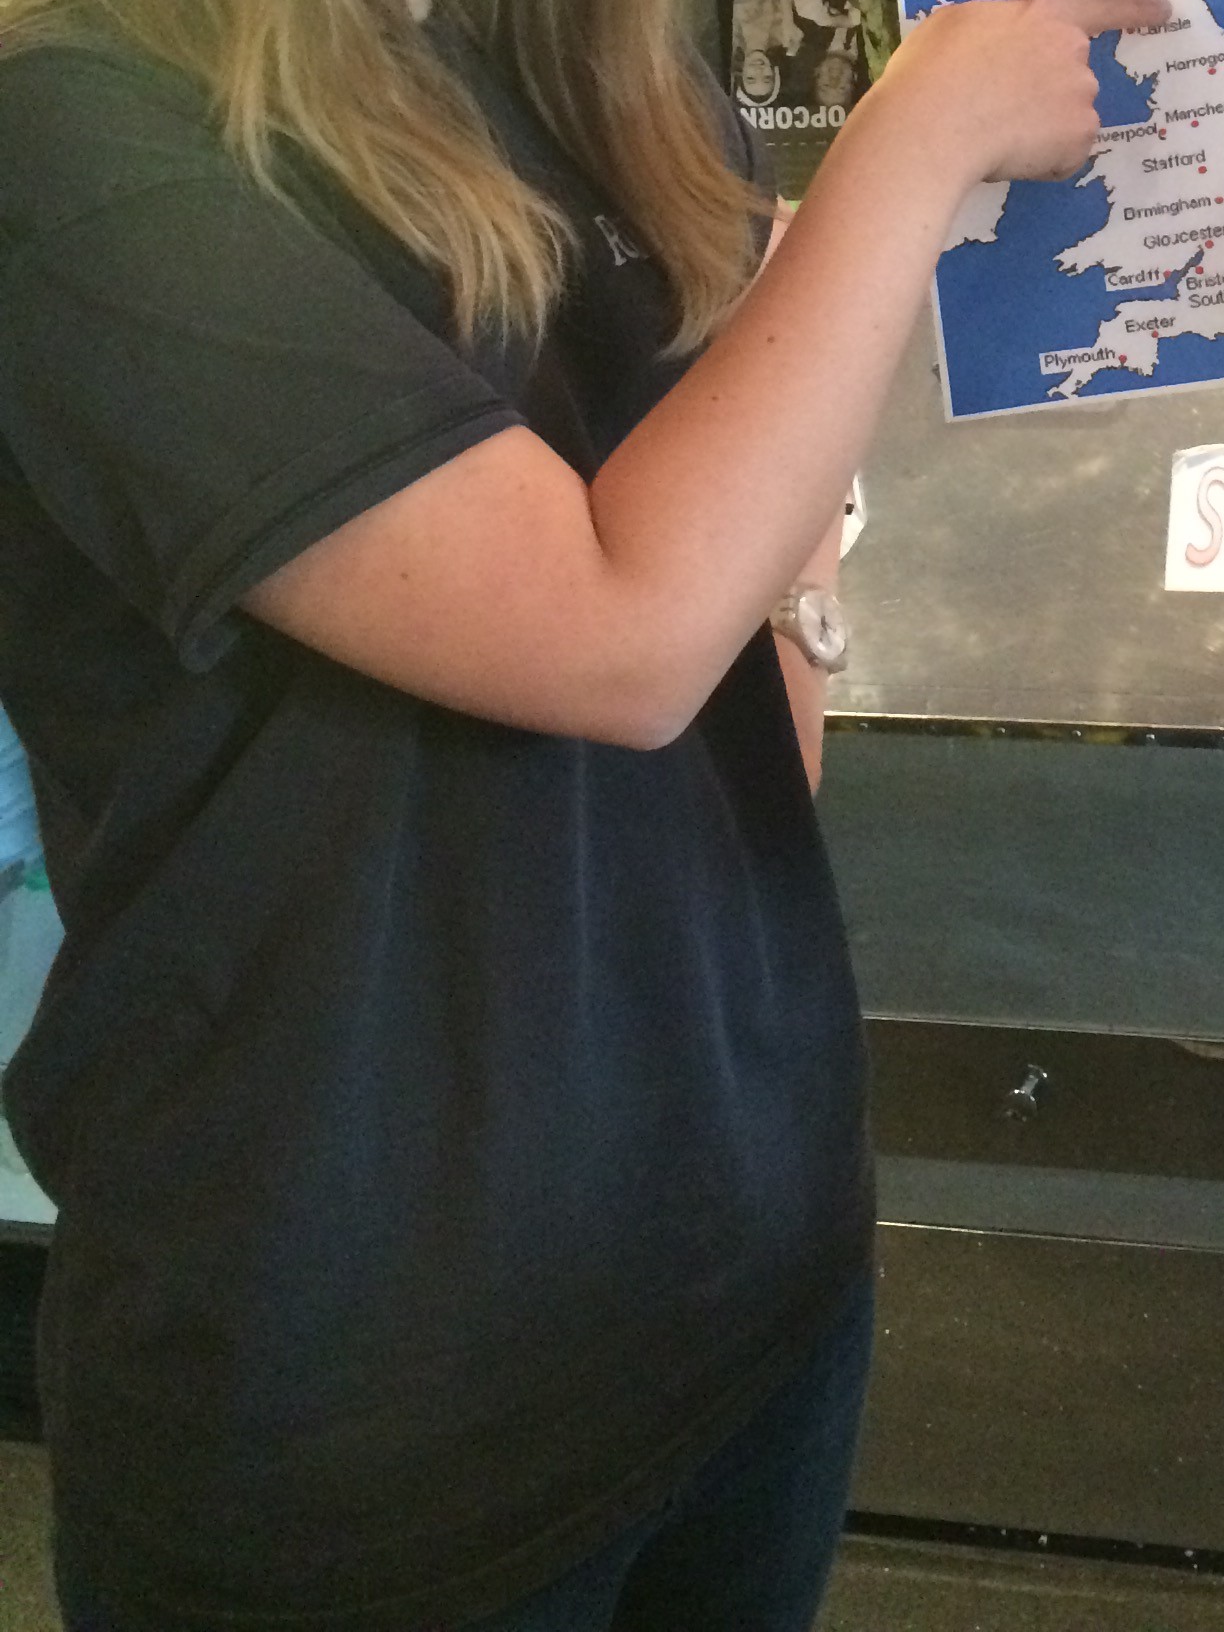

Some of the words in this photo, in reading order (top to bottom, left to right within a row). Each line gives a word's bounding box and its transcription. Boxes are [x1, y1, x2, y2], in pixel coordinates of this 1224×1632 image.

[740, 104, 848, 130] OPCORN
[1125, 315, 1176, 334] Exeter
[1043, 347, 1116, 369] Plymouth
